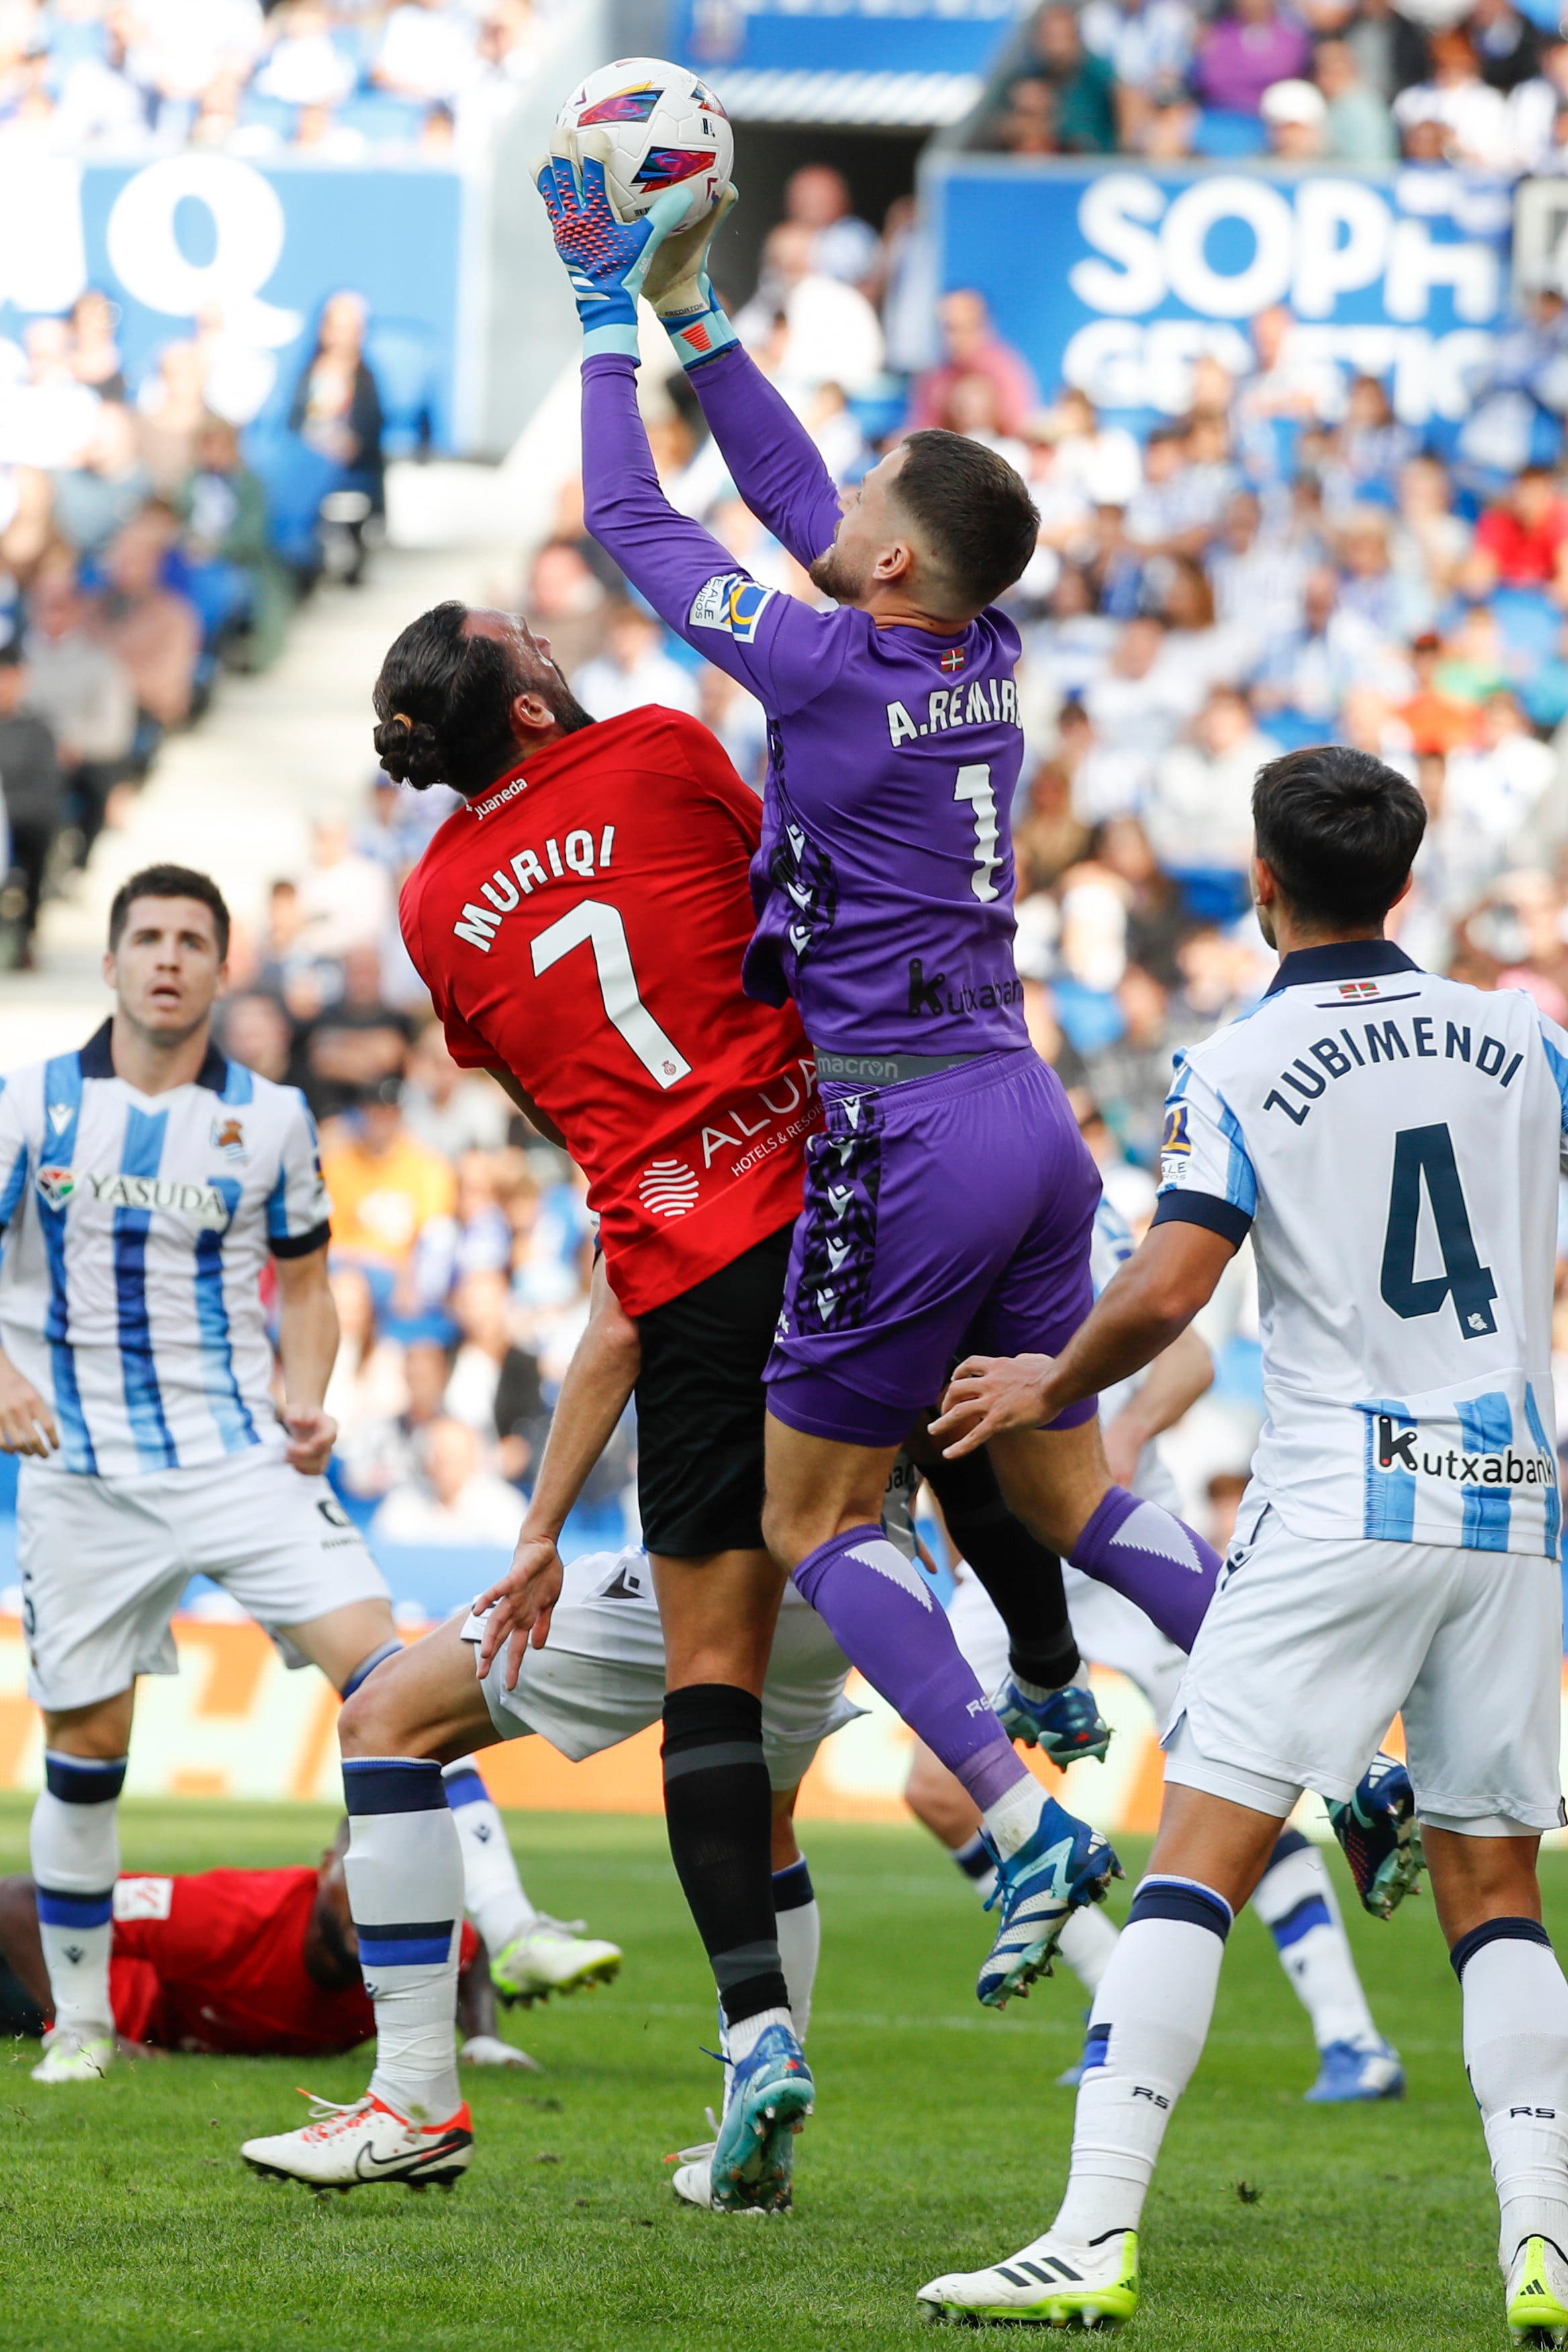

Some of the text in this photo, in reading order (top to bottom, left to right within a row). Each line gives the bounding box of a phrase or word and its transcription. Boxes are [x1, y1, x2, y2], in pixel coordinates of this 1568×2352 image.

[953, 763, 1004, 903] 1
[453, 825, 616, 953] MURIQI
[530, 898, 693, 1091] 7
[818, 1056, 898, 1078] macron
[1263, 1017, 1524, 1126] ZUBIMENDI
[730, 1137, 778, 1177] HOTELS
[777, 1131, 789, 1144] &
[89, 1172, 226, 1215] YASUDA
[1380, 1122, 1499, 1340] 4
[965, 1695, 990, 1718] RS
[1132, 2086, 1170, 2109] RS
[1510, 2106, 1555, 2119] RS
